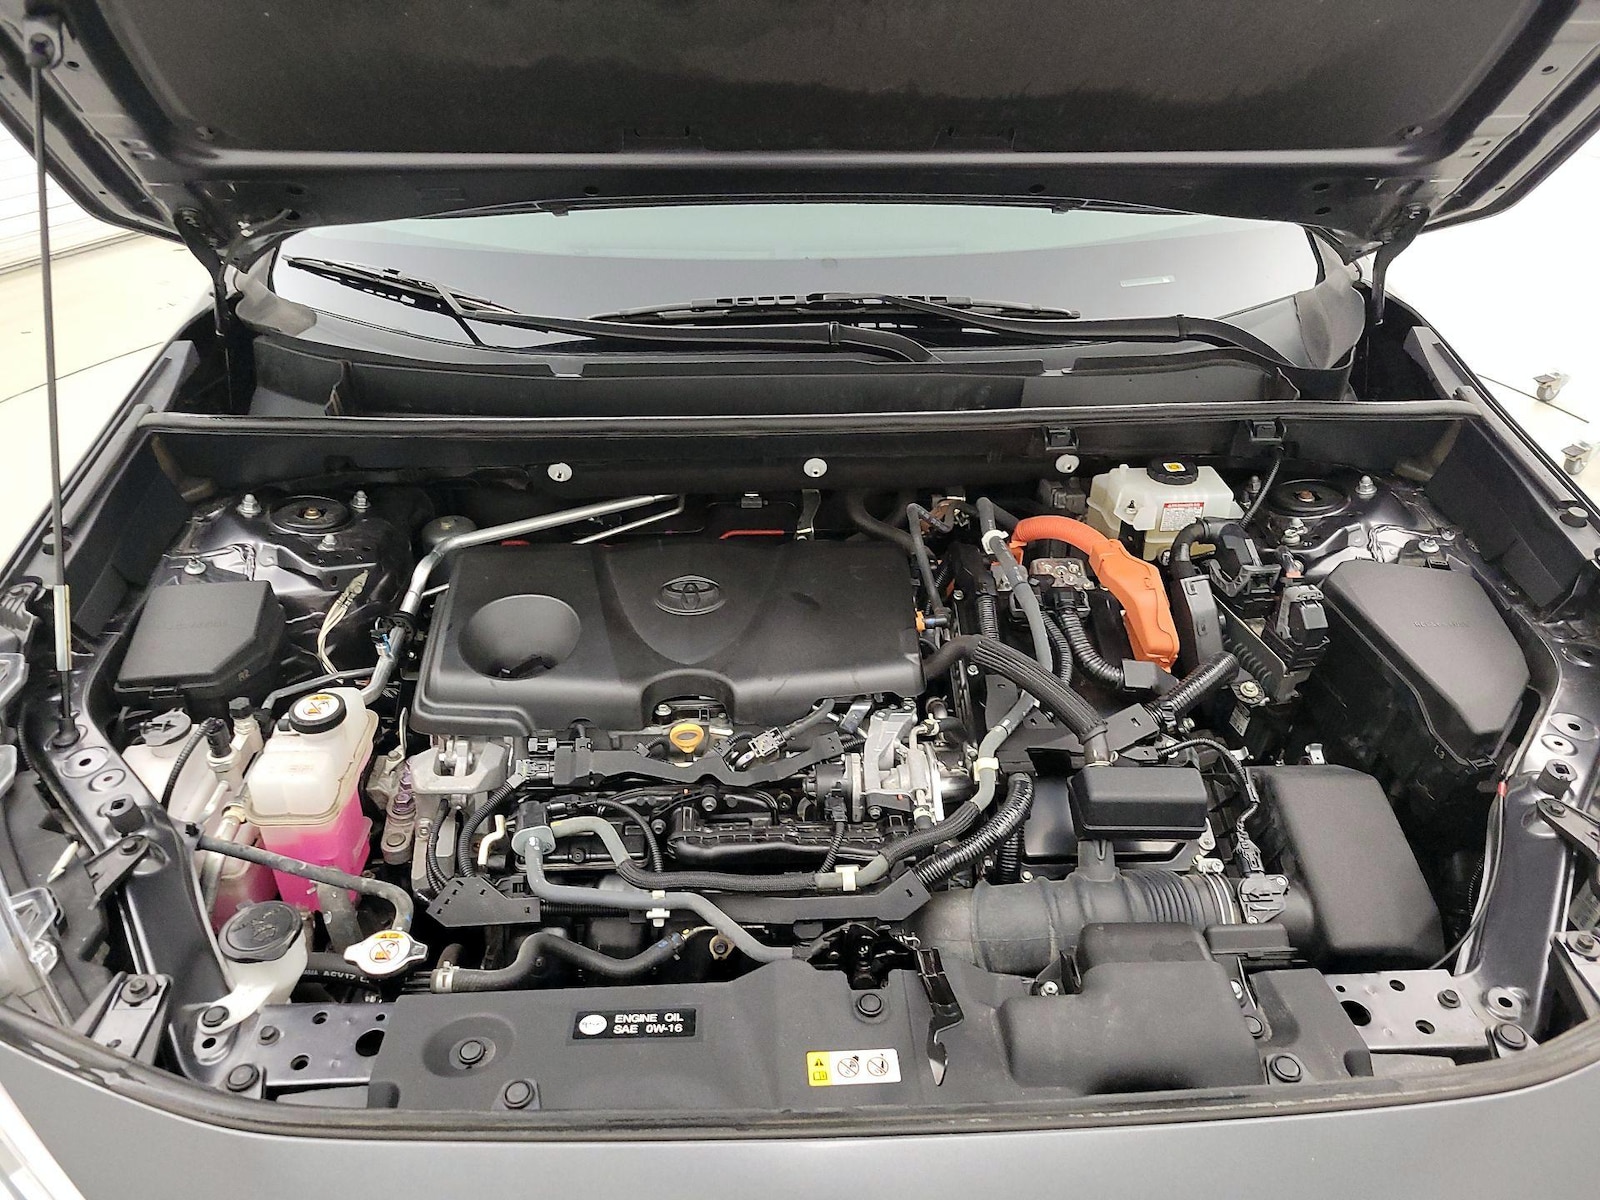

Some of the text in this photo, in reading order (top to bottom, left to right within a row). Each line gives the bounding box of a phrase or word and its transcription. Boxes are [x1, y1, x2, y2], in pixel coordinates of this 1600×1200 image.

[614, 1012, 685, 1024] ENGINE OIL
[613, 1024, 639, 1035] SAE
[645, 1023, 683, 1034] 0W-16
